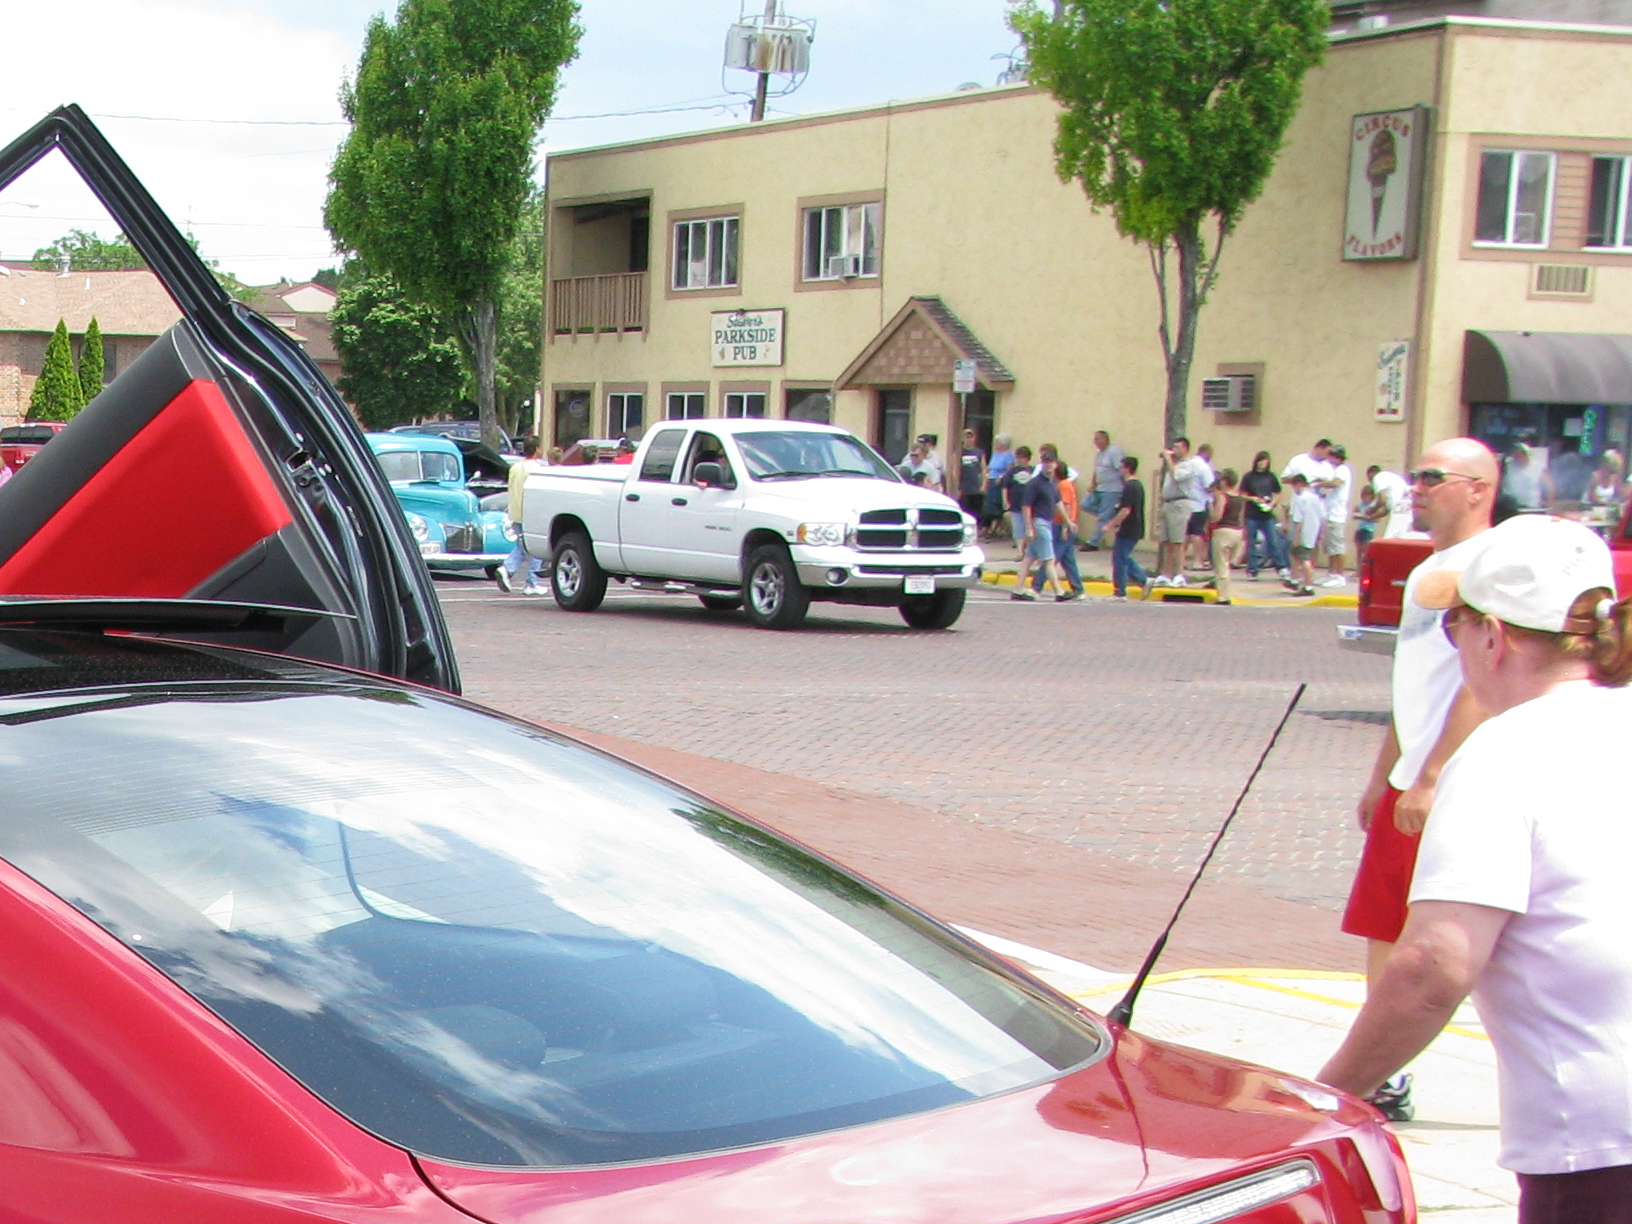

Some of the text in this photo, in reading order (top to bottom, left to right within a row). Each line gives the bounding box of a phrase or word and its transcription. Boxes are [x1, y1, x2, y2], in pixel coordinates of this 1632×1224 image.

[1355, 114, 1410, 141] CIRCUS
[714, 328, 775, 344] PARKSIDE
[732, 345, 757, 361] PUB
